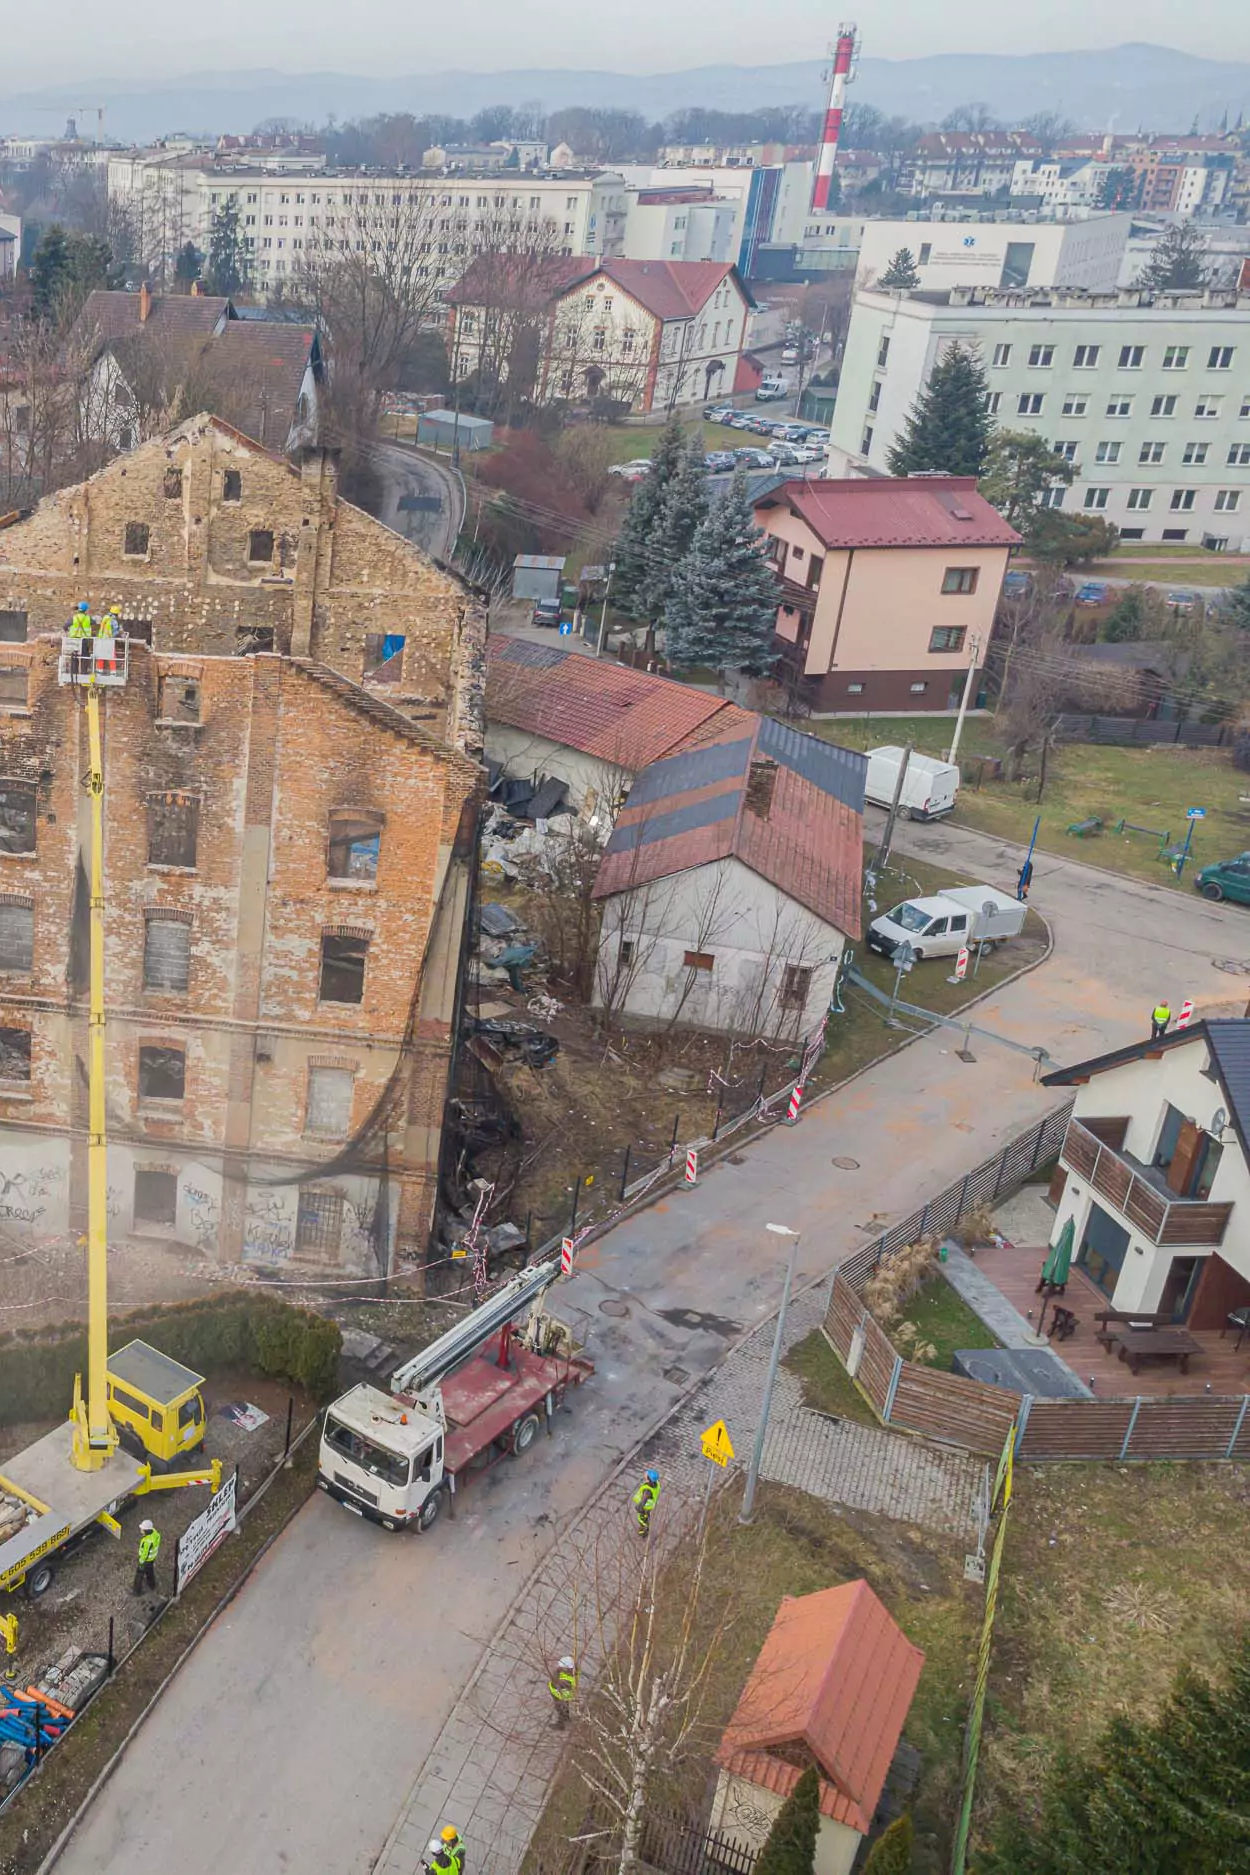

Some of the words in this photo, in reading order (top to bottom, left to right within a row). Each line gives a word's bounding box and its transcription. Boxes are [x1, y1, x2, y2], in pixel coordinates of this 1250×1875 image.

[206, 1478, 233, 1518] SKLEP
[8, 1557, 27, 1576] 605
[29, 1541, 48, 1560] 539
